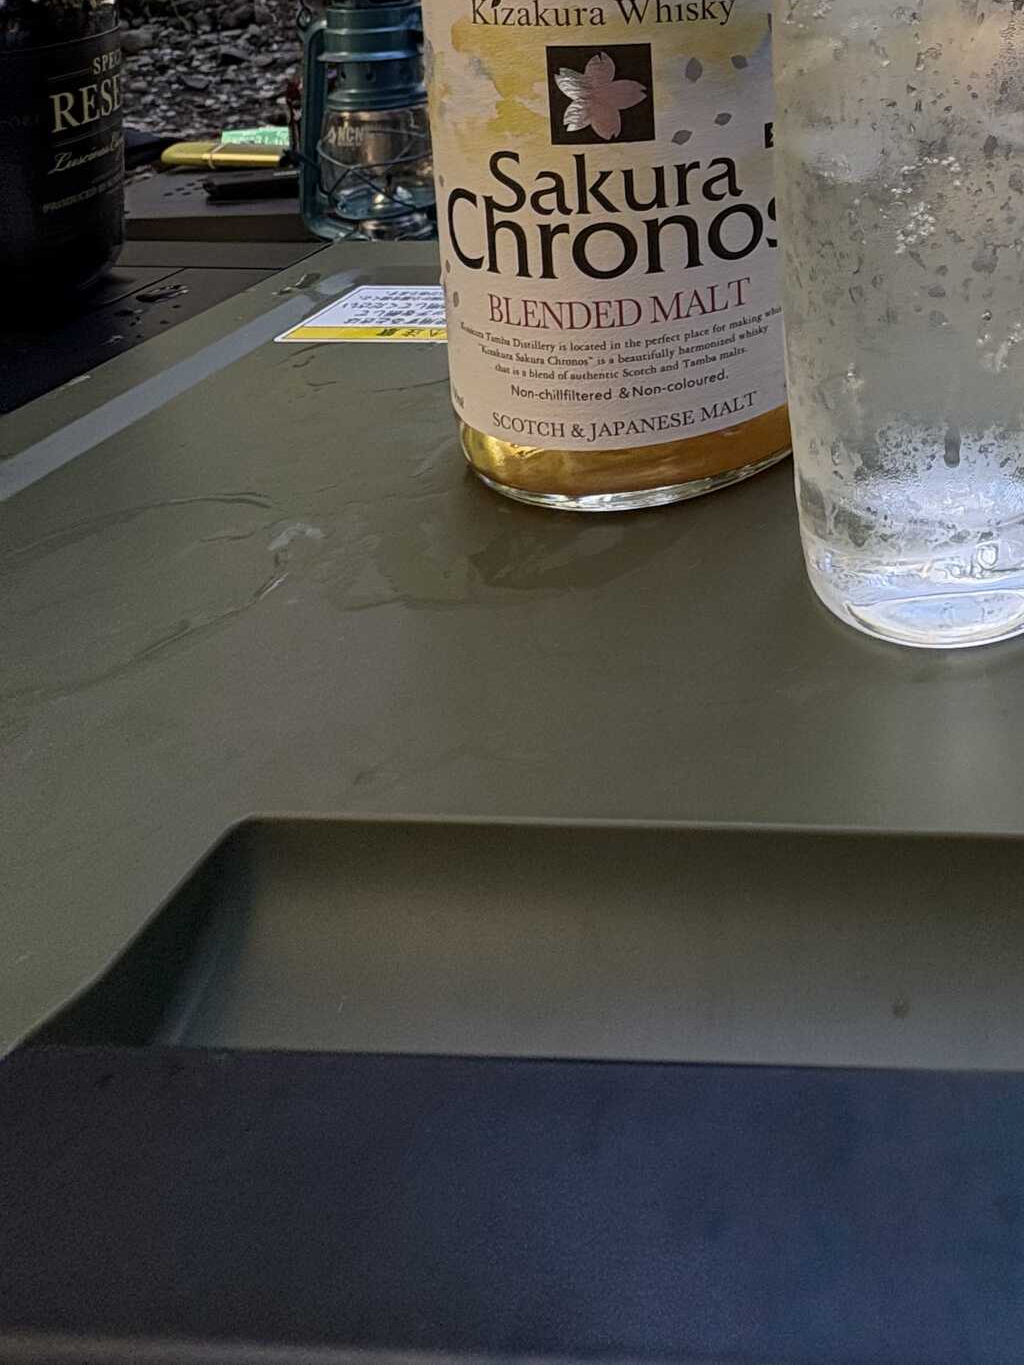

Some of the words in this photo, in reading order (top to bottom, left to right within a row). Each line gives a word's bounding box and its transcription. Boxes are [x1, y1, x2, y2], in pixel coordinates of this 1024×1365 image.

[488, 150, 743, 216] Sakura
[487, 292, 642, 331] BLENDED
[650, 276, 751, 325] MALT
[512, 337, 556, 353] Distillery
[559, 341, 567, 351] is
[570, 339, 607, 352] located
[610, 340, 621, 350] in
[624, 338, 642, 349] the
[644, 332, 681, 349] perfect
[684, 328, 710, 343] place
[712, 323, 727, 335] for
[729, 313, 763, 330] making
[515, 352, 545, 366] Sakura
[597, 355, 606, 366] is
[617, 347, 675, 365] beautifully
[678, 335, 736, 355] harmonized
[510, 383, 612, 402] Non-chillfiltered
[632, 369, 730, 400] Non-coloured.
[529, 368, 555, 380] blend
[557, 368, 569, 380] of
[570, 368, 619, 381] authentic
[622, 364, 657, 378] Scotch
[660, 361, 679, 373] and
[683, 353, 717, 370] Tamba
[491, 411, 566, 438] SCOTCH
[570, 424, 585, 439] &
[586, 409, 695, 443] JAPANESE
[700, 390, 759, 423] MALT
